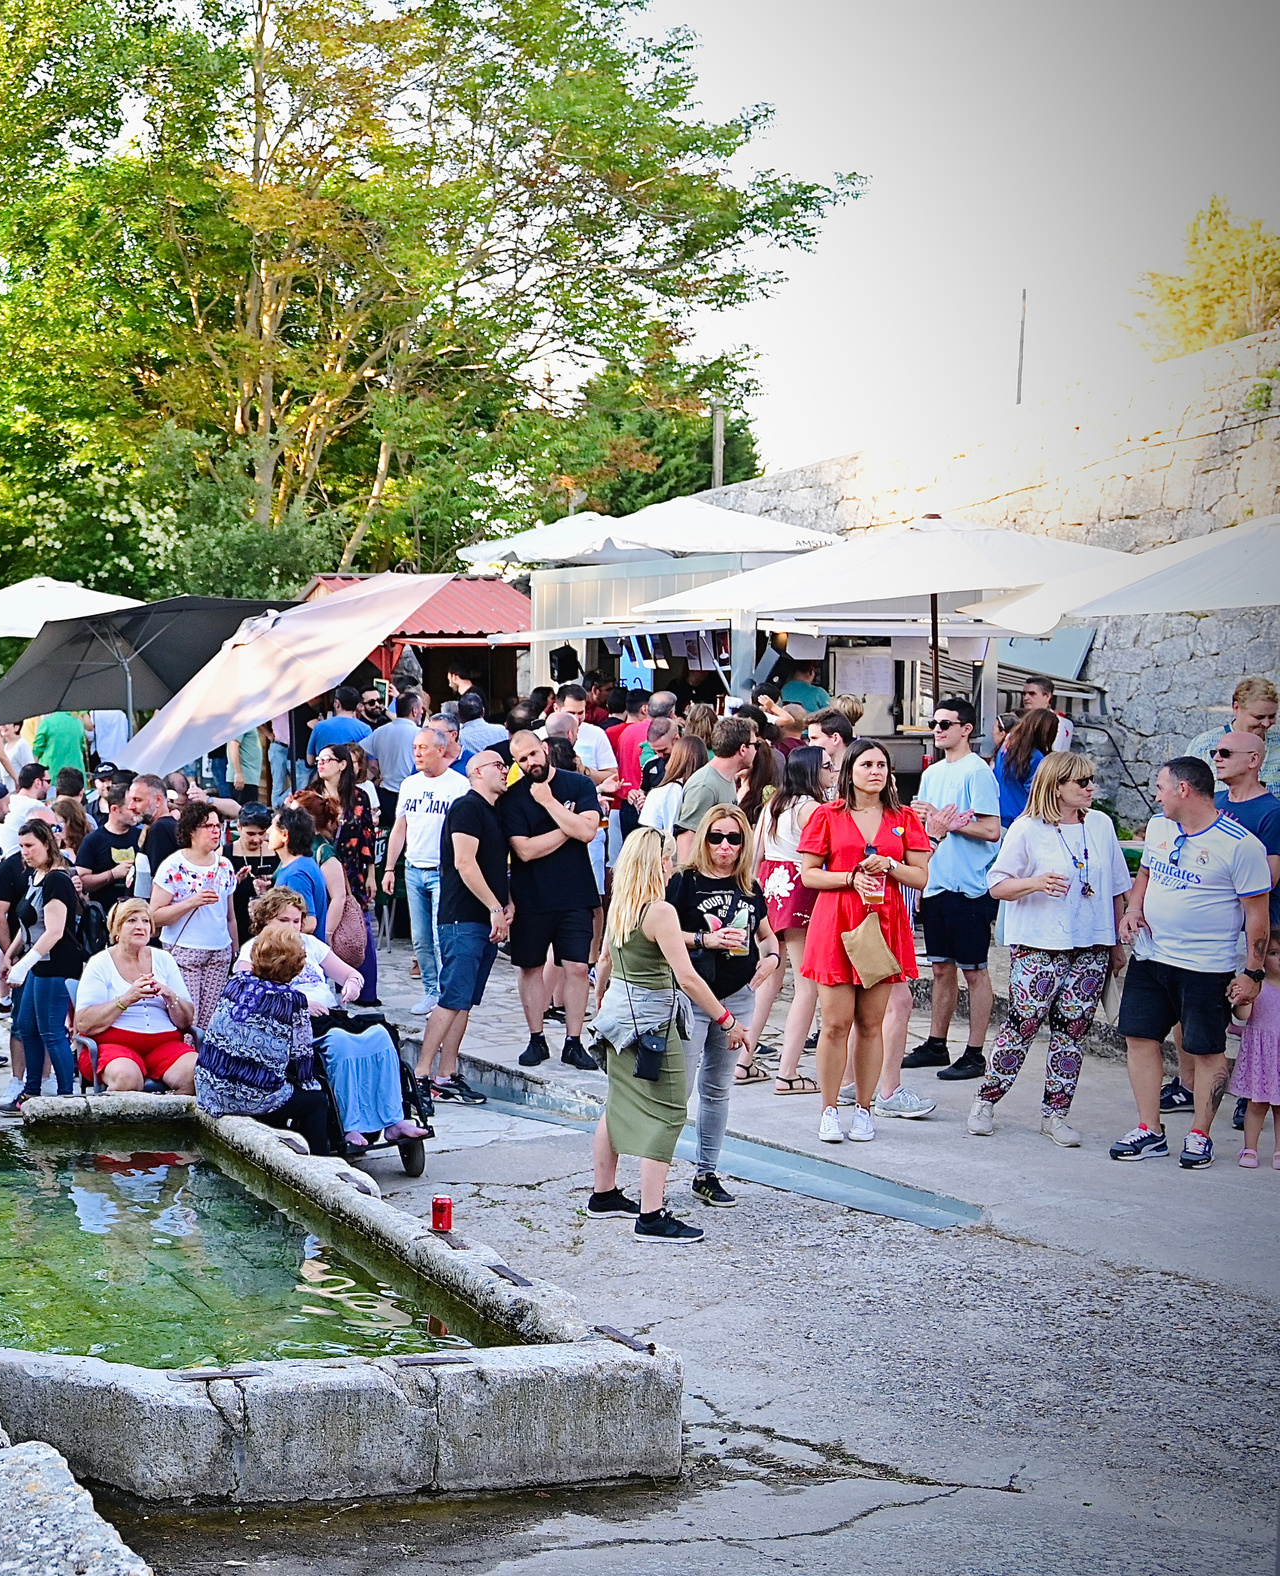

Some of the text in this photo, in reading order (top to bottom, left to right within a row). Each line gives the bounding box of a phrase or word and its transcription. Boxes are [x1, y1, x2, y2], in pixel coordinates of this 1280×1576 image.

[795, 540, 833, 548] AMST
[422, 791, 435, 800] THE
[1150, 856, 1202, 885] Emirates
[697, 895, 756, 913] YOUR WNGS
